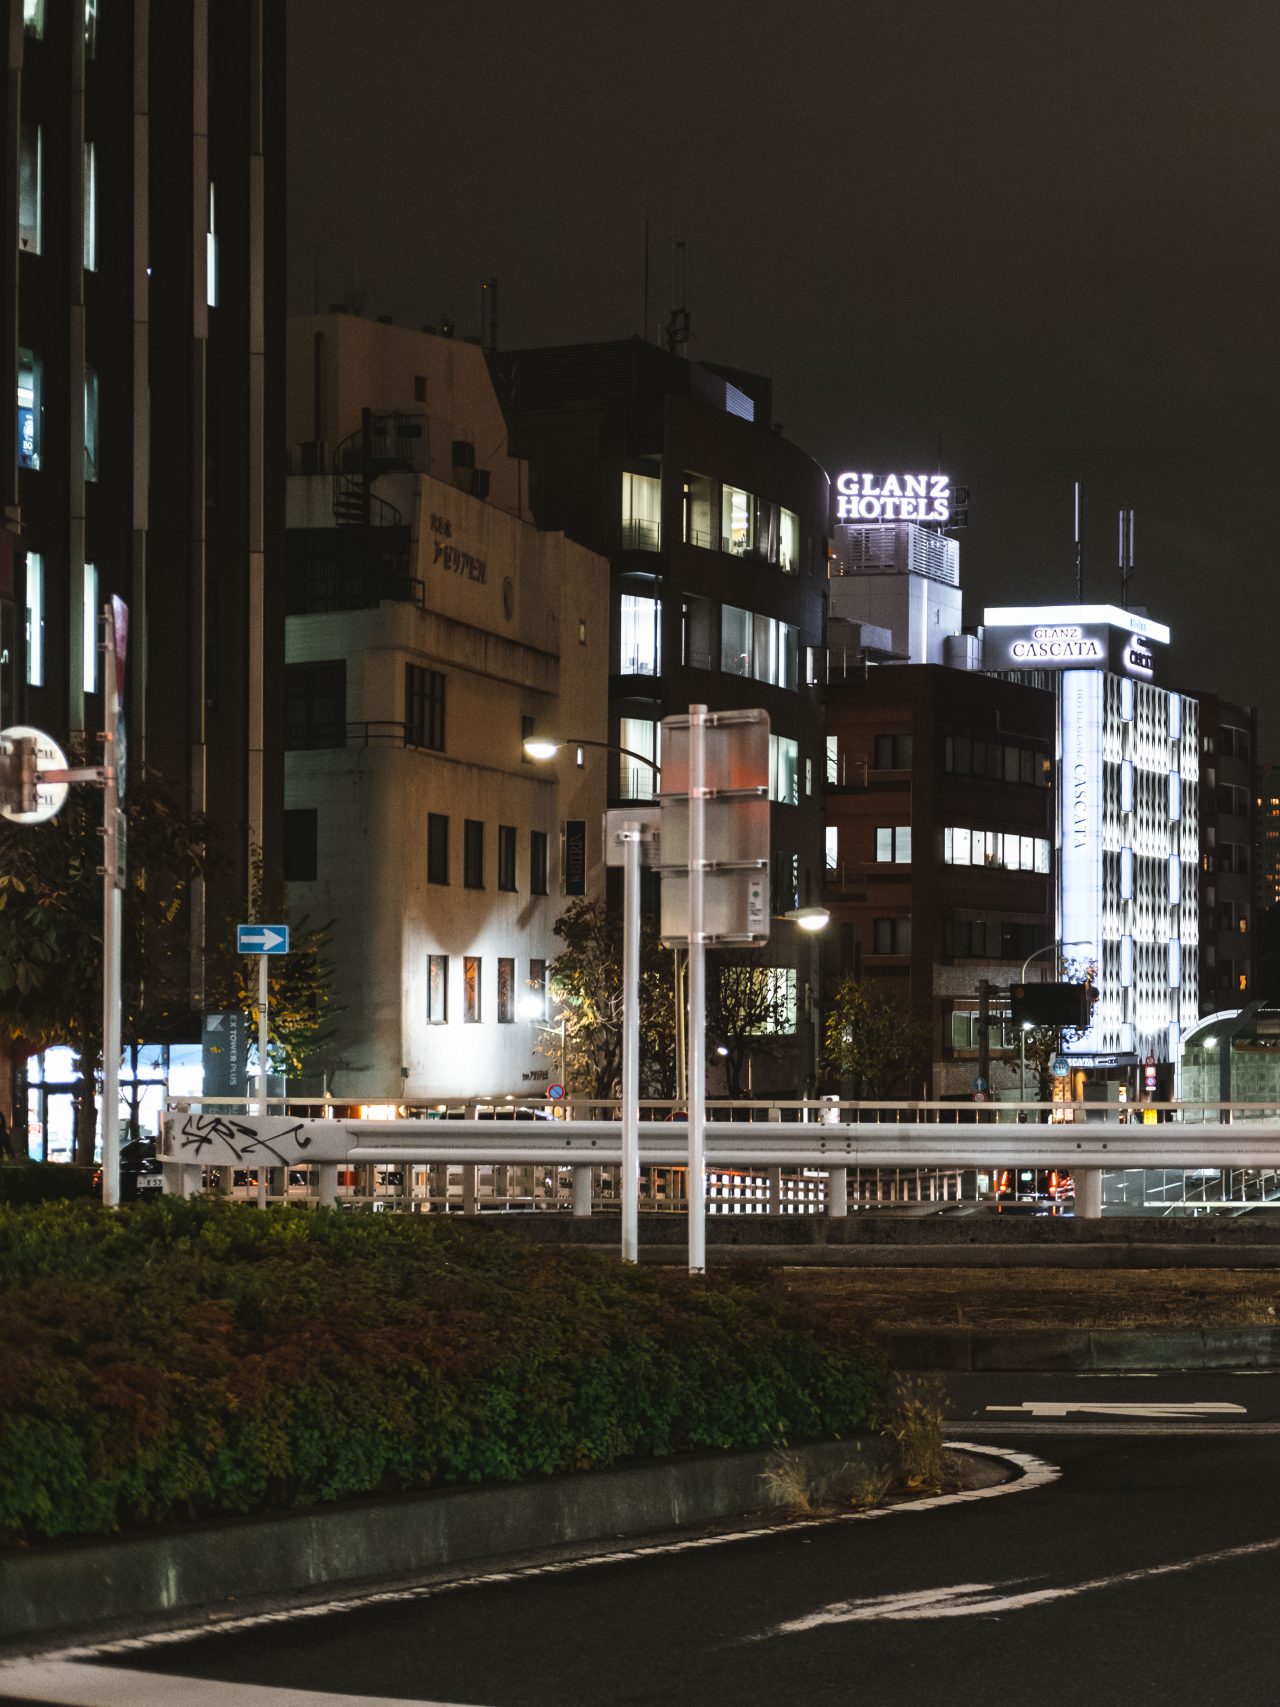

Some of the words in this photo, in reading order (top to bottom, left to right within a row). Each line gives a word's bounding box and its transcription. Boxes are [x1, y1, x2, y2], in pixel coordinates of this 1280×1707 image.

[837, 472, 950, 498] GLANZ
[837, 496, 949, 520] HOTELS
[1034, 628, 1078, 639] GLANZ
[1012, 641, 1098, 657] CASCATA
[1073, 764, 1087, 849] CASCATA
[229, 1014, 237, 1027] EX
[229, 1030, 237, 1062] TOWER
[229, 1063, 237, 1086] PLUS
